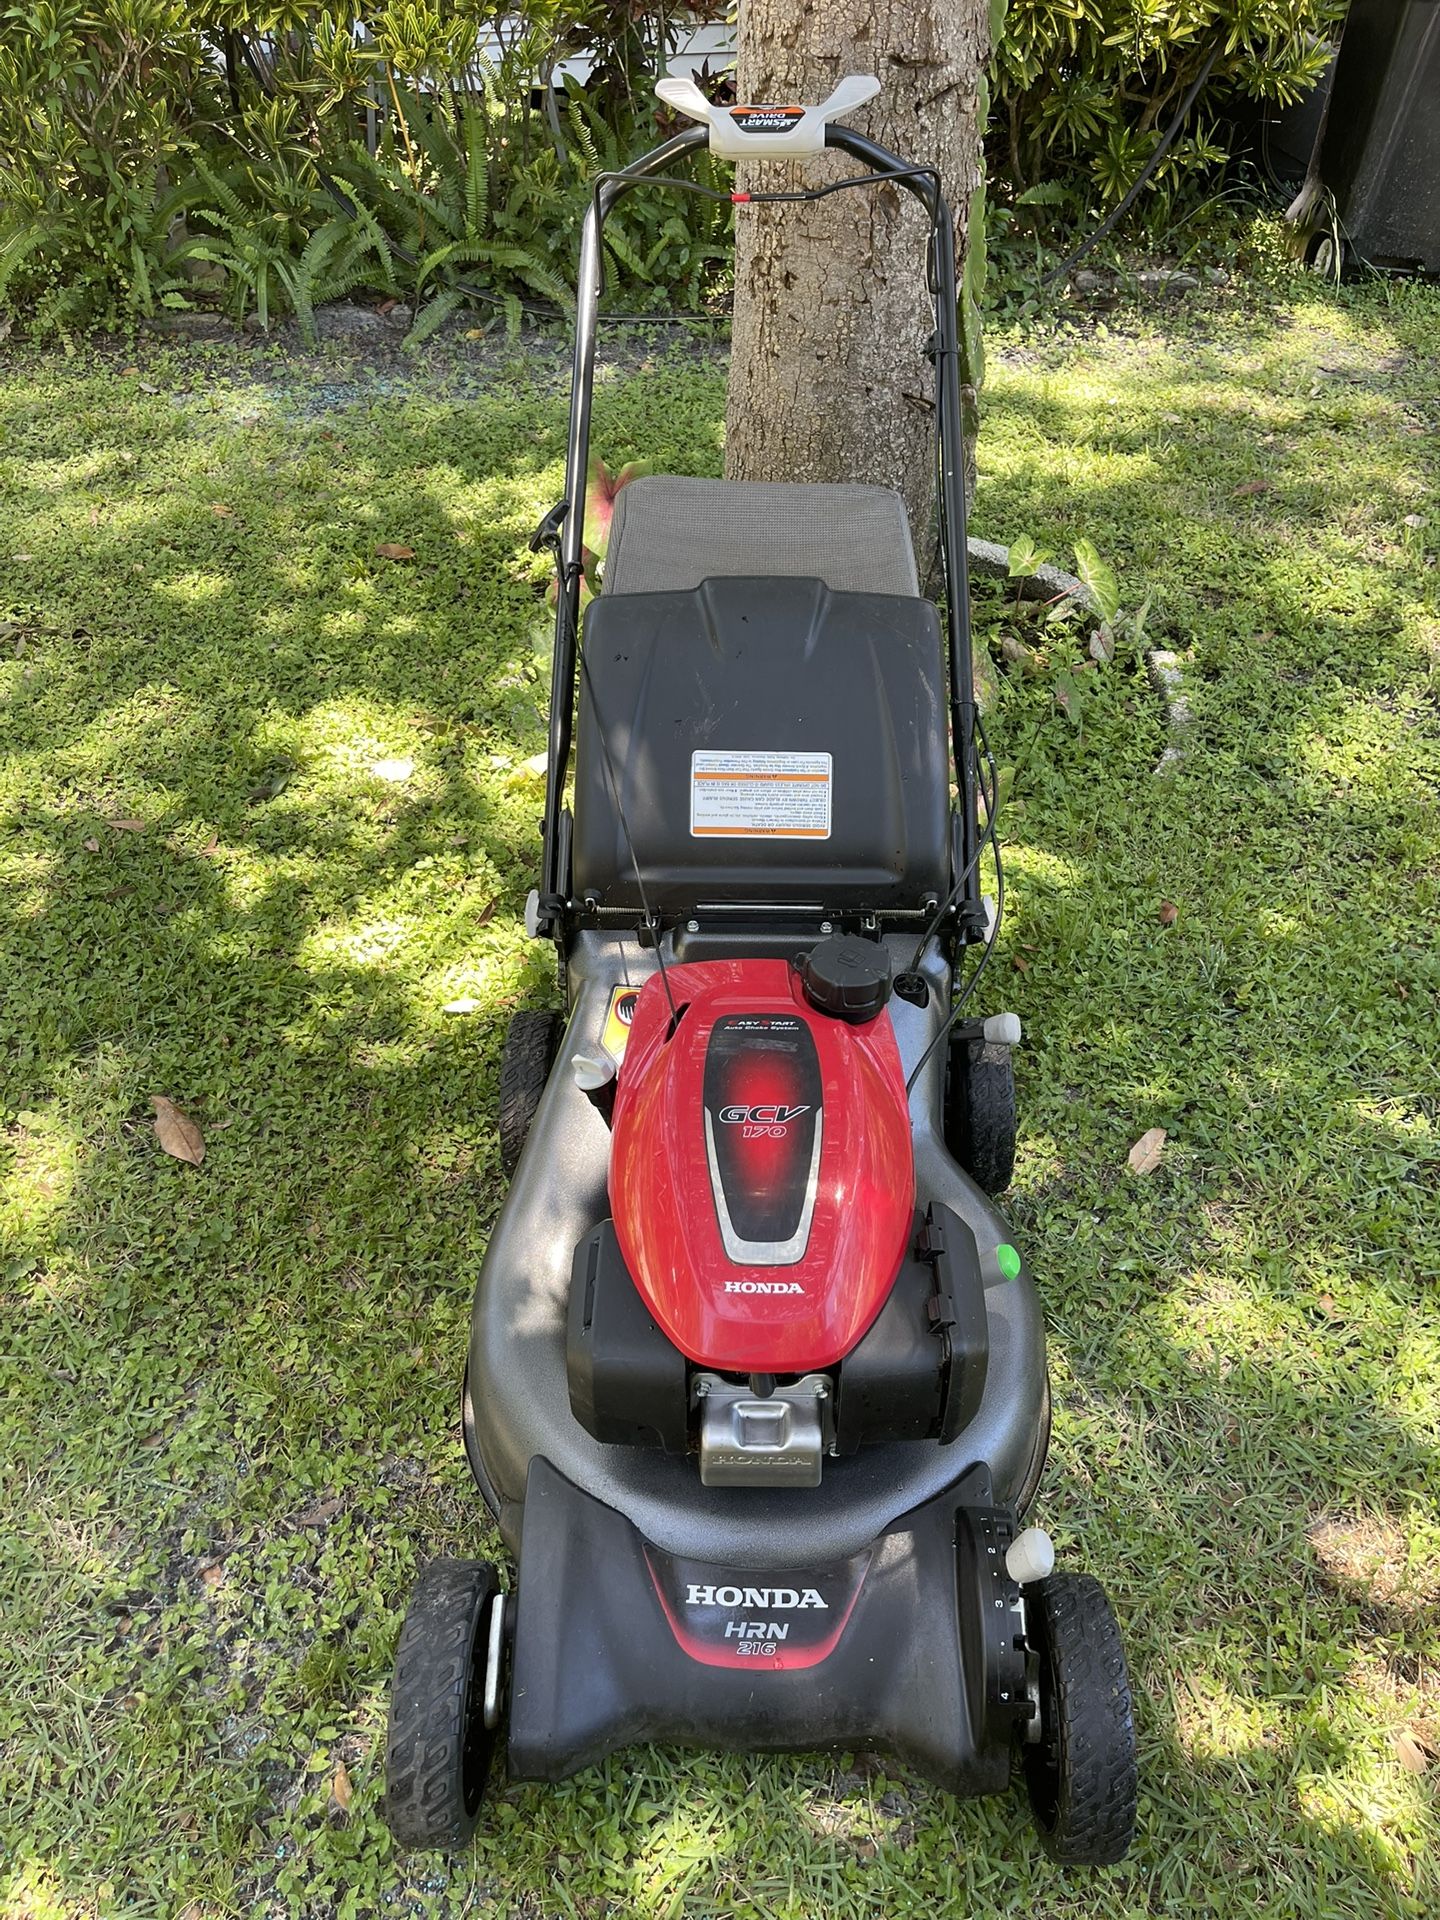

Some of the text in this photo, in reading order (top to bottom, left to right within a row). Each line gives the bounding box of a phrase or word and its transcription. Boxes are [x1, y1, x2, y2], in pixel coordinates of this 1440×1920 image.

[719, 1105, 811, 1124] GCV
[742, 1125, 788, 1138] 170
[724, 1281, 805, 1294] HONDA
[712, 1455, 812, 1466] HONDA
[987, 1546, 996, 1554] 2
[685, 1584, 829, 1609] HONDA
[994, 1599, 1004, 1608] 3
[724, 1621, 789, 1640] HRN
[736, 1641, 777, 1655] 216
[1000, 1691, 1010, 1700] 4
